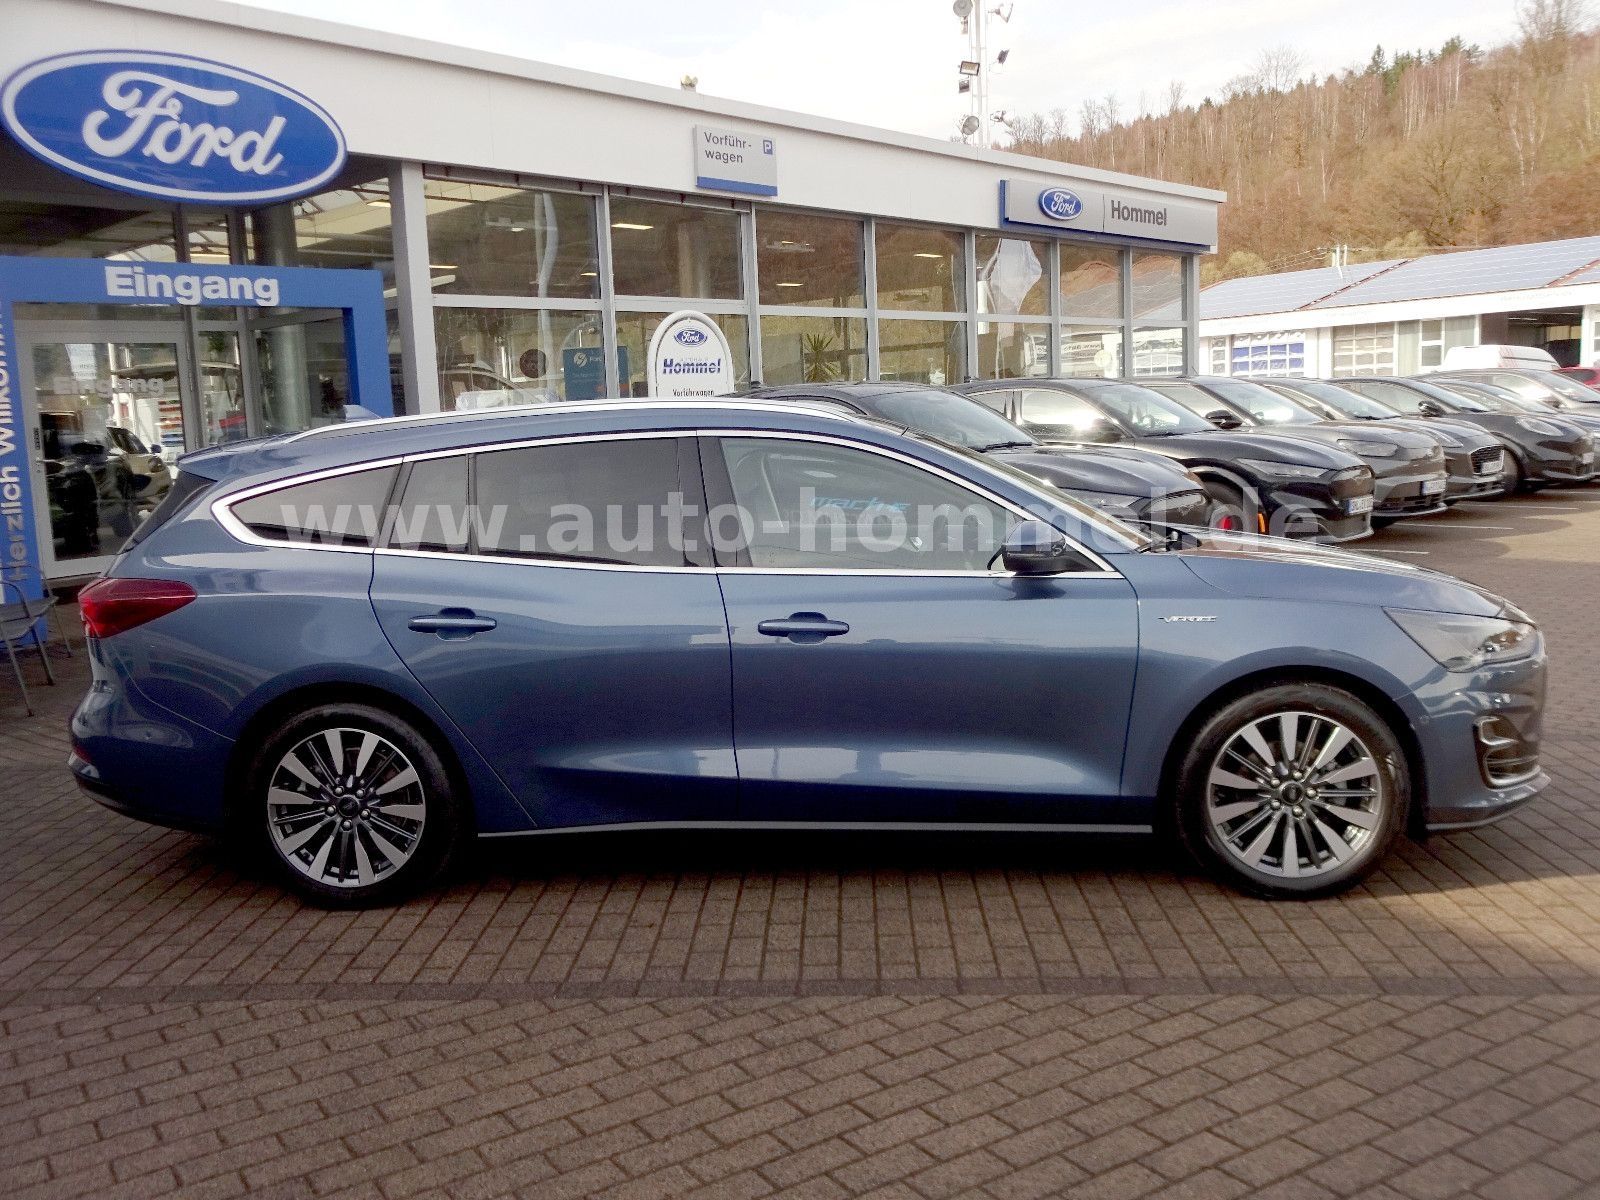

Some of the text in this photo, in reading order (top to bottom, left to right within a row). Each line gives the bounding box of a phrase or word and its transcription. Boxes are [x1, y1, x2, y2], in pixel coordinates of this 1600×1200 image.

[82, 70, 287, 176] Ford
[704, 131, 752, 149] Vorführ-
[705, 149, 743, 164] wagen
[1051, 192, 1076, 215] Ford
[1111, 200, 1167, 226] Hommel
[105, 266, 279, 307] Eingang
[681, 330, 700, 343] Ford
[663, 358, 722, 375] Hommel
[0, 466, 29, 581] Herzlich
